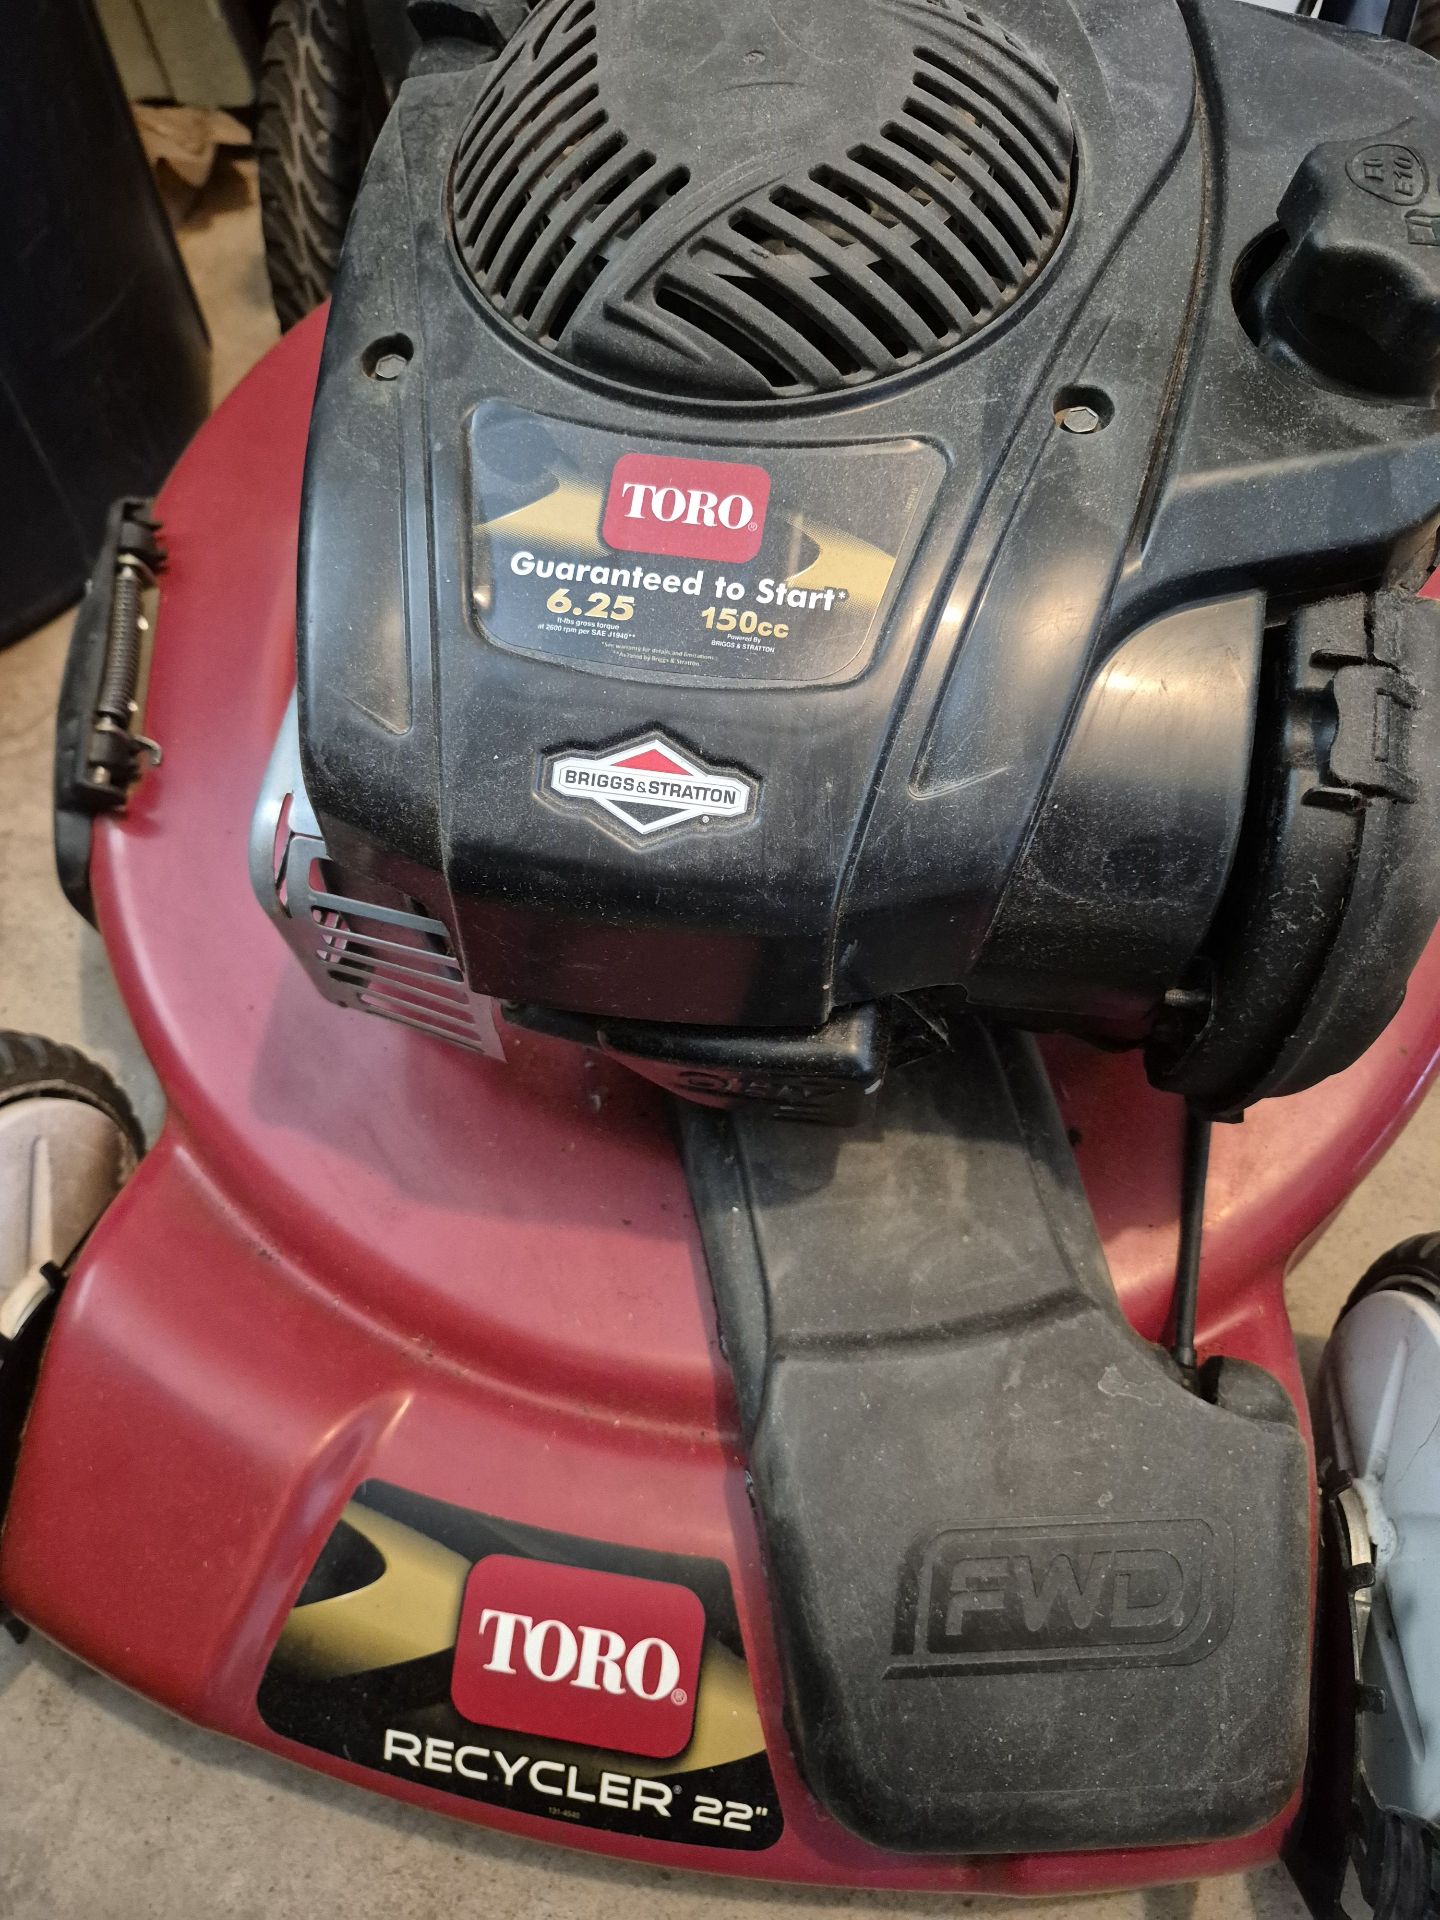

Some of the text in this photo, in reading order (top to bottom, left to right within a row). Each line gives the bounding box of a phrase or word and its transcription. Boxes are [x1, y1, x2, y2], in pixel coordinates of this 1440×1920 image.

[510, 550, 704, 597] Guaranteed
[714, 576, 746, 601] to
[545, 588, 636, 622] 6.25
[545, 624, 562, 632] 2600
[563, 626, 577, 634] rpm
[578, 628, 590, 636] per
[591, 629, 606, 637] SAE
[576, 620, 595, 629] gross
[596, 621, 620, 631] torque
[700, 606, 790, 639] 150cc
[727, 633, 762, 644] Powered By
[711, 639, 735, 649] BRIGGS
[742, 643, 775, 653] STRATTON
[944, 1547, 1185, 1637] FWD
[692, 1793, 770, 1832] 22"
